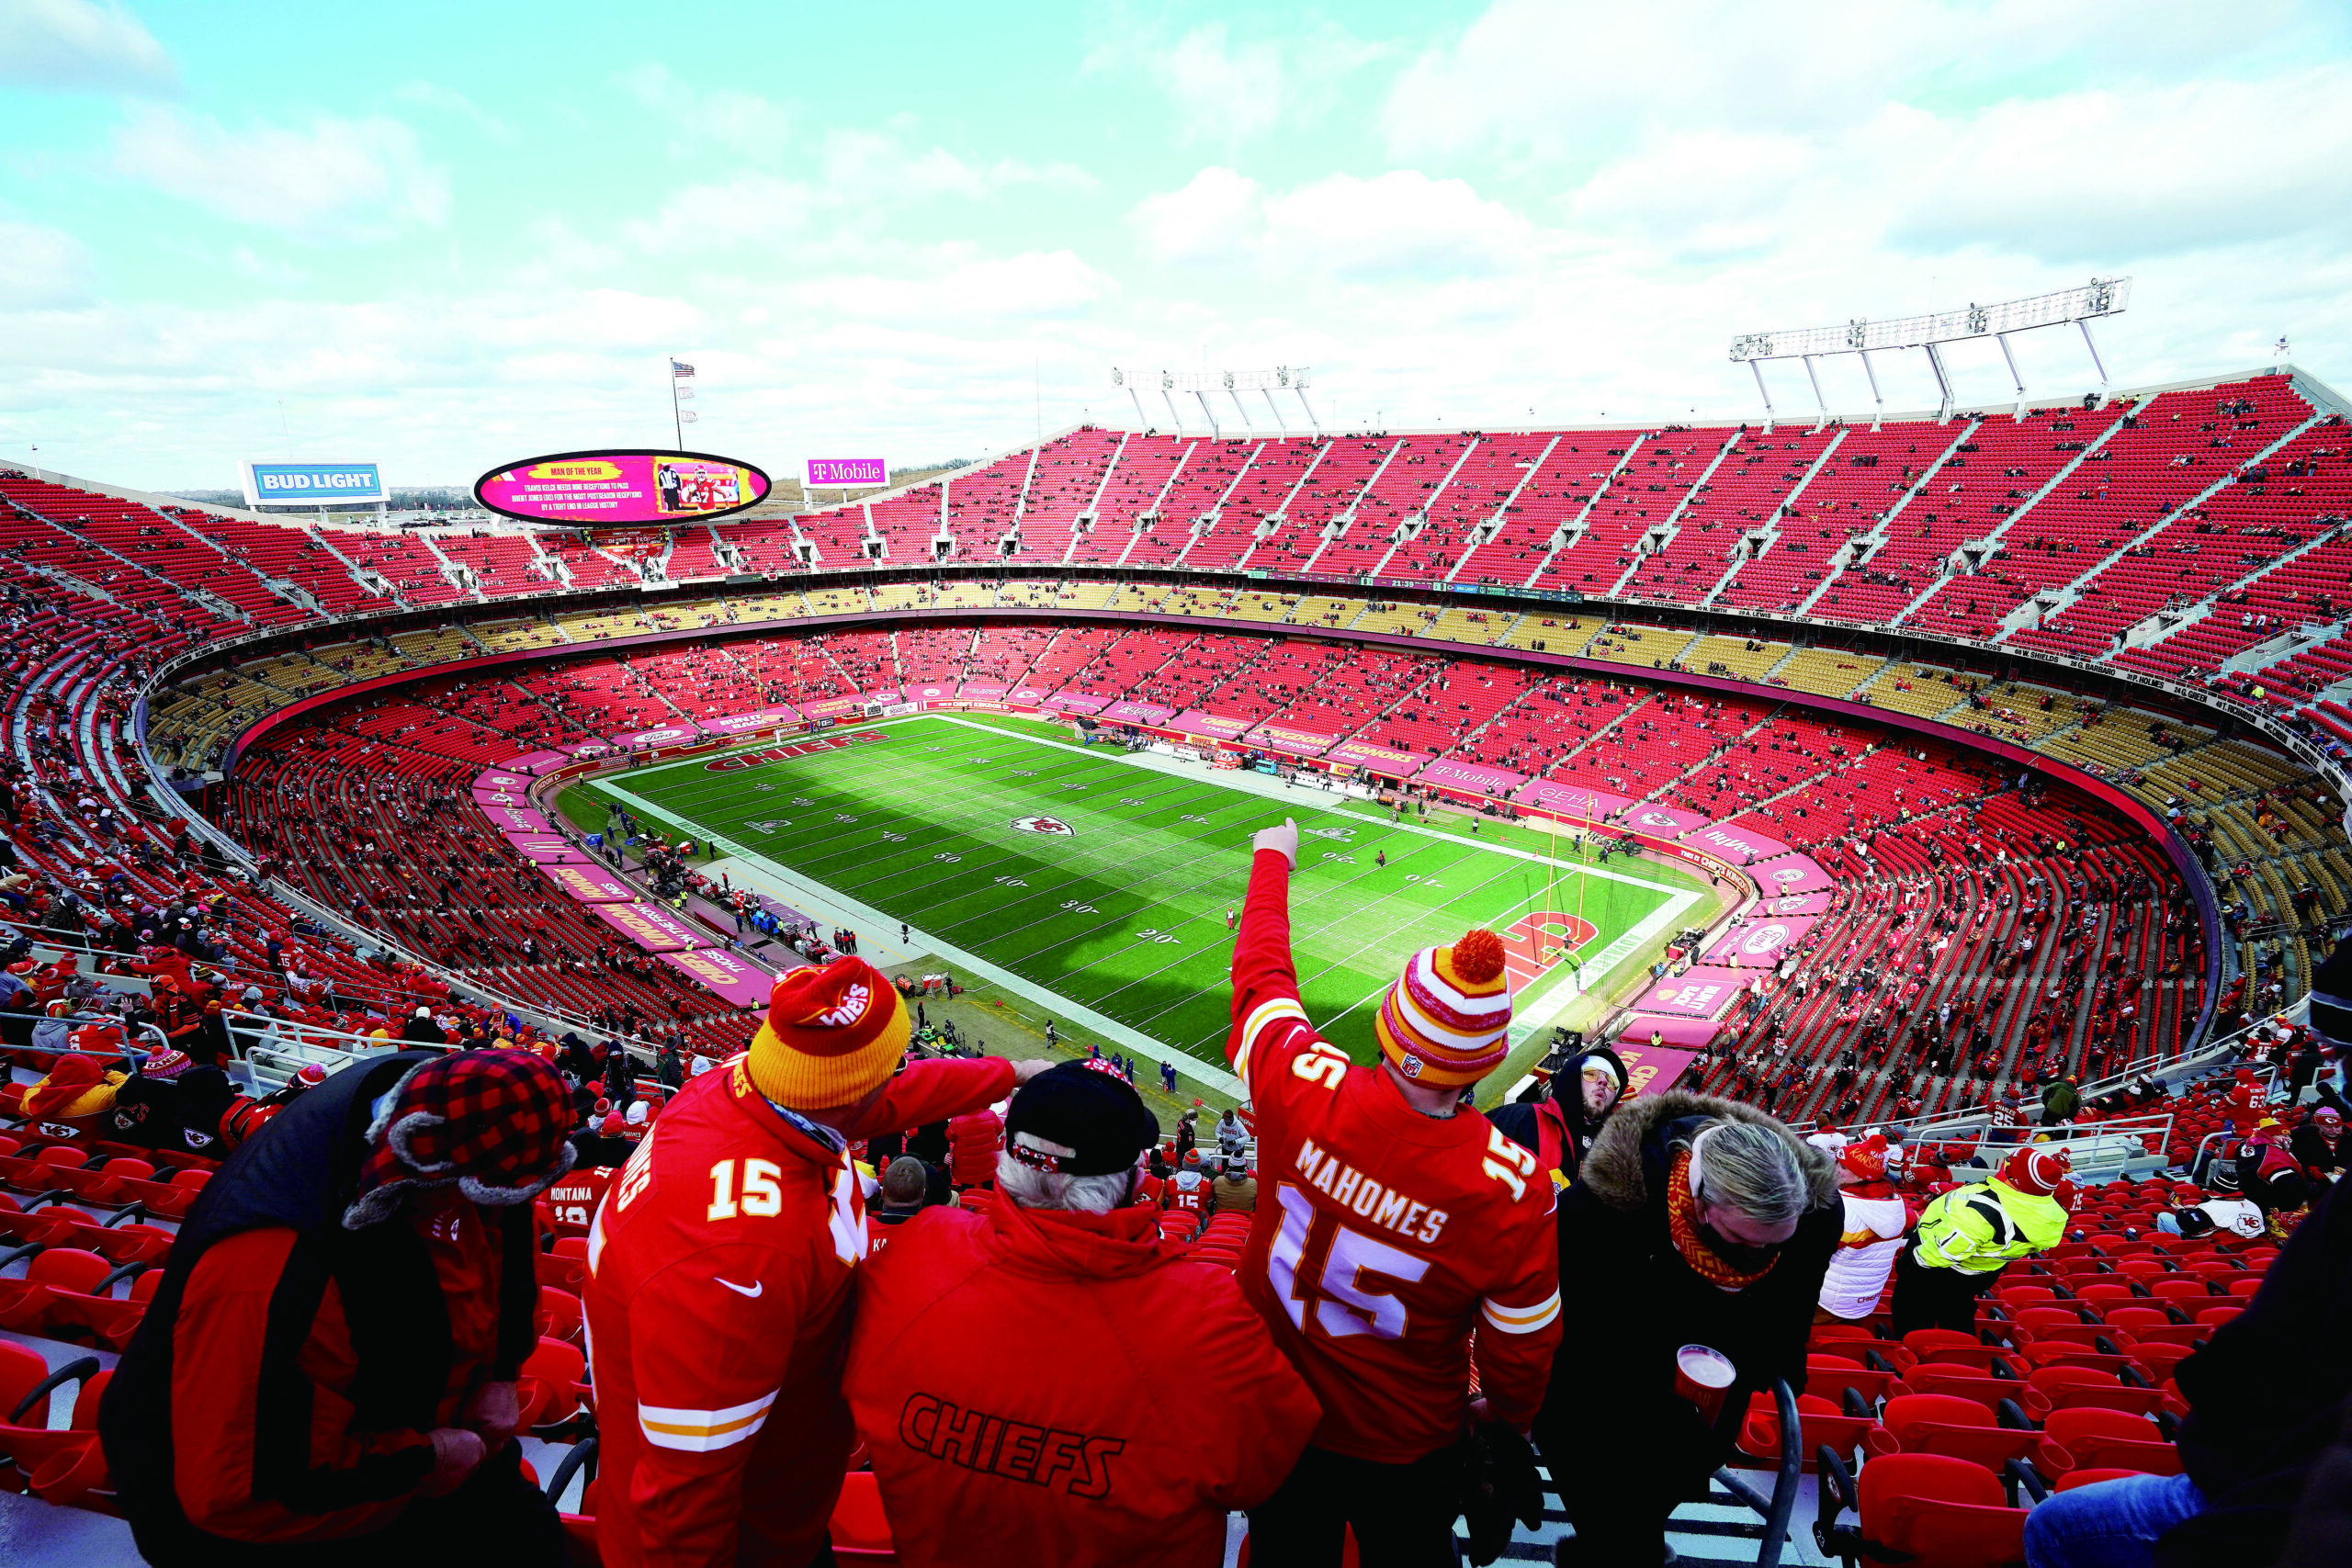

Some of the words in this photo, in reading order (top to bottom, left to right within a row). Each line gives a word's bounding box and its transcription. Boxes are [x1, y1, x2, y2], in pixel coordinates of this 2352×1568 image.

[550, 468, 566, 476] MAN
[566, 468, 574, 476] OF
[575, 468, 586, 476] THE
[587, 467, 602, 475] YEAR
[263, 474, 311, 490] BUD
[312, 473, 372, 489] LIGHT
[1391, 580, 1415, 588] 21:39
[1837, 622, 1862, 630] LOWERY
[1874, 626, 1897, 636] MARTY
[1898, 629, 1958, 644] SCHOTTENHEIMER
[1984, 643, 2002, 652] ROSS
[2031, 651, 2059, 663] SHIELDS
[2085, 663, 2115, 676] BARBARO
[2138, 676, 2165, 689] HOLMES
[2188, 690, 2208, 703] GREEN
[2228, 705, 2256, 724] RICHARDSON
[1200, 717, 1250, 730] CHIEFS
[1205, 726, 1238, 736] THOSE
[644, 731, 673, 741] Ford
[1254, 727, 1333, 747] KINGDOM
[704, 729, 889, 772] CHIEFS
[1289, 741, 1322, 752] FRONT
[1341, 743, 1417, 763] HONORS
[1333, 750, 1366, 761] LINES
[1539, 787, 1599, 808] GEHA
[713, 838, 757, 860] CHANGE
[933, 851, 962, 863] 50
[553, 868, 610, 898] HONORS
[600, 882, 629, 898] LINES
[994, 875, 1022, 888] 40
[630, 903, 665, 922] FRONT
[1059, 898, 1091, 915] 30
[600, 904, 681, 947] KINGDOM
[1136, 927, 1173, 945] 20
[669, 953, 739, 985] CHIEFS
[701, 950, 746, 973] THOSE
[1290, 1039, 1351, 1091] 15
[1995, 1103, 2017, 1117] CHARLES
[1993, 1111, 2015, 1127] 25
[1481, 1124, 1537, 1203] 15
[550, 1186, 593, 1201] MONTANA
[707, 1157, 783, 1223] 15
[1294, 1137, 1449, 1246] MAHOMES
[1177, 1194, 1199, 1209] 15
[1267, 1180, 1433, 1340] 15
[899, 1392, 1126, 1502] CHIEFS
